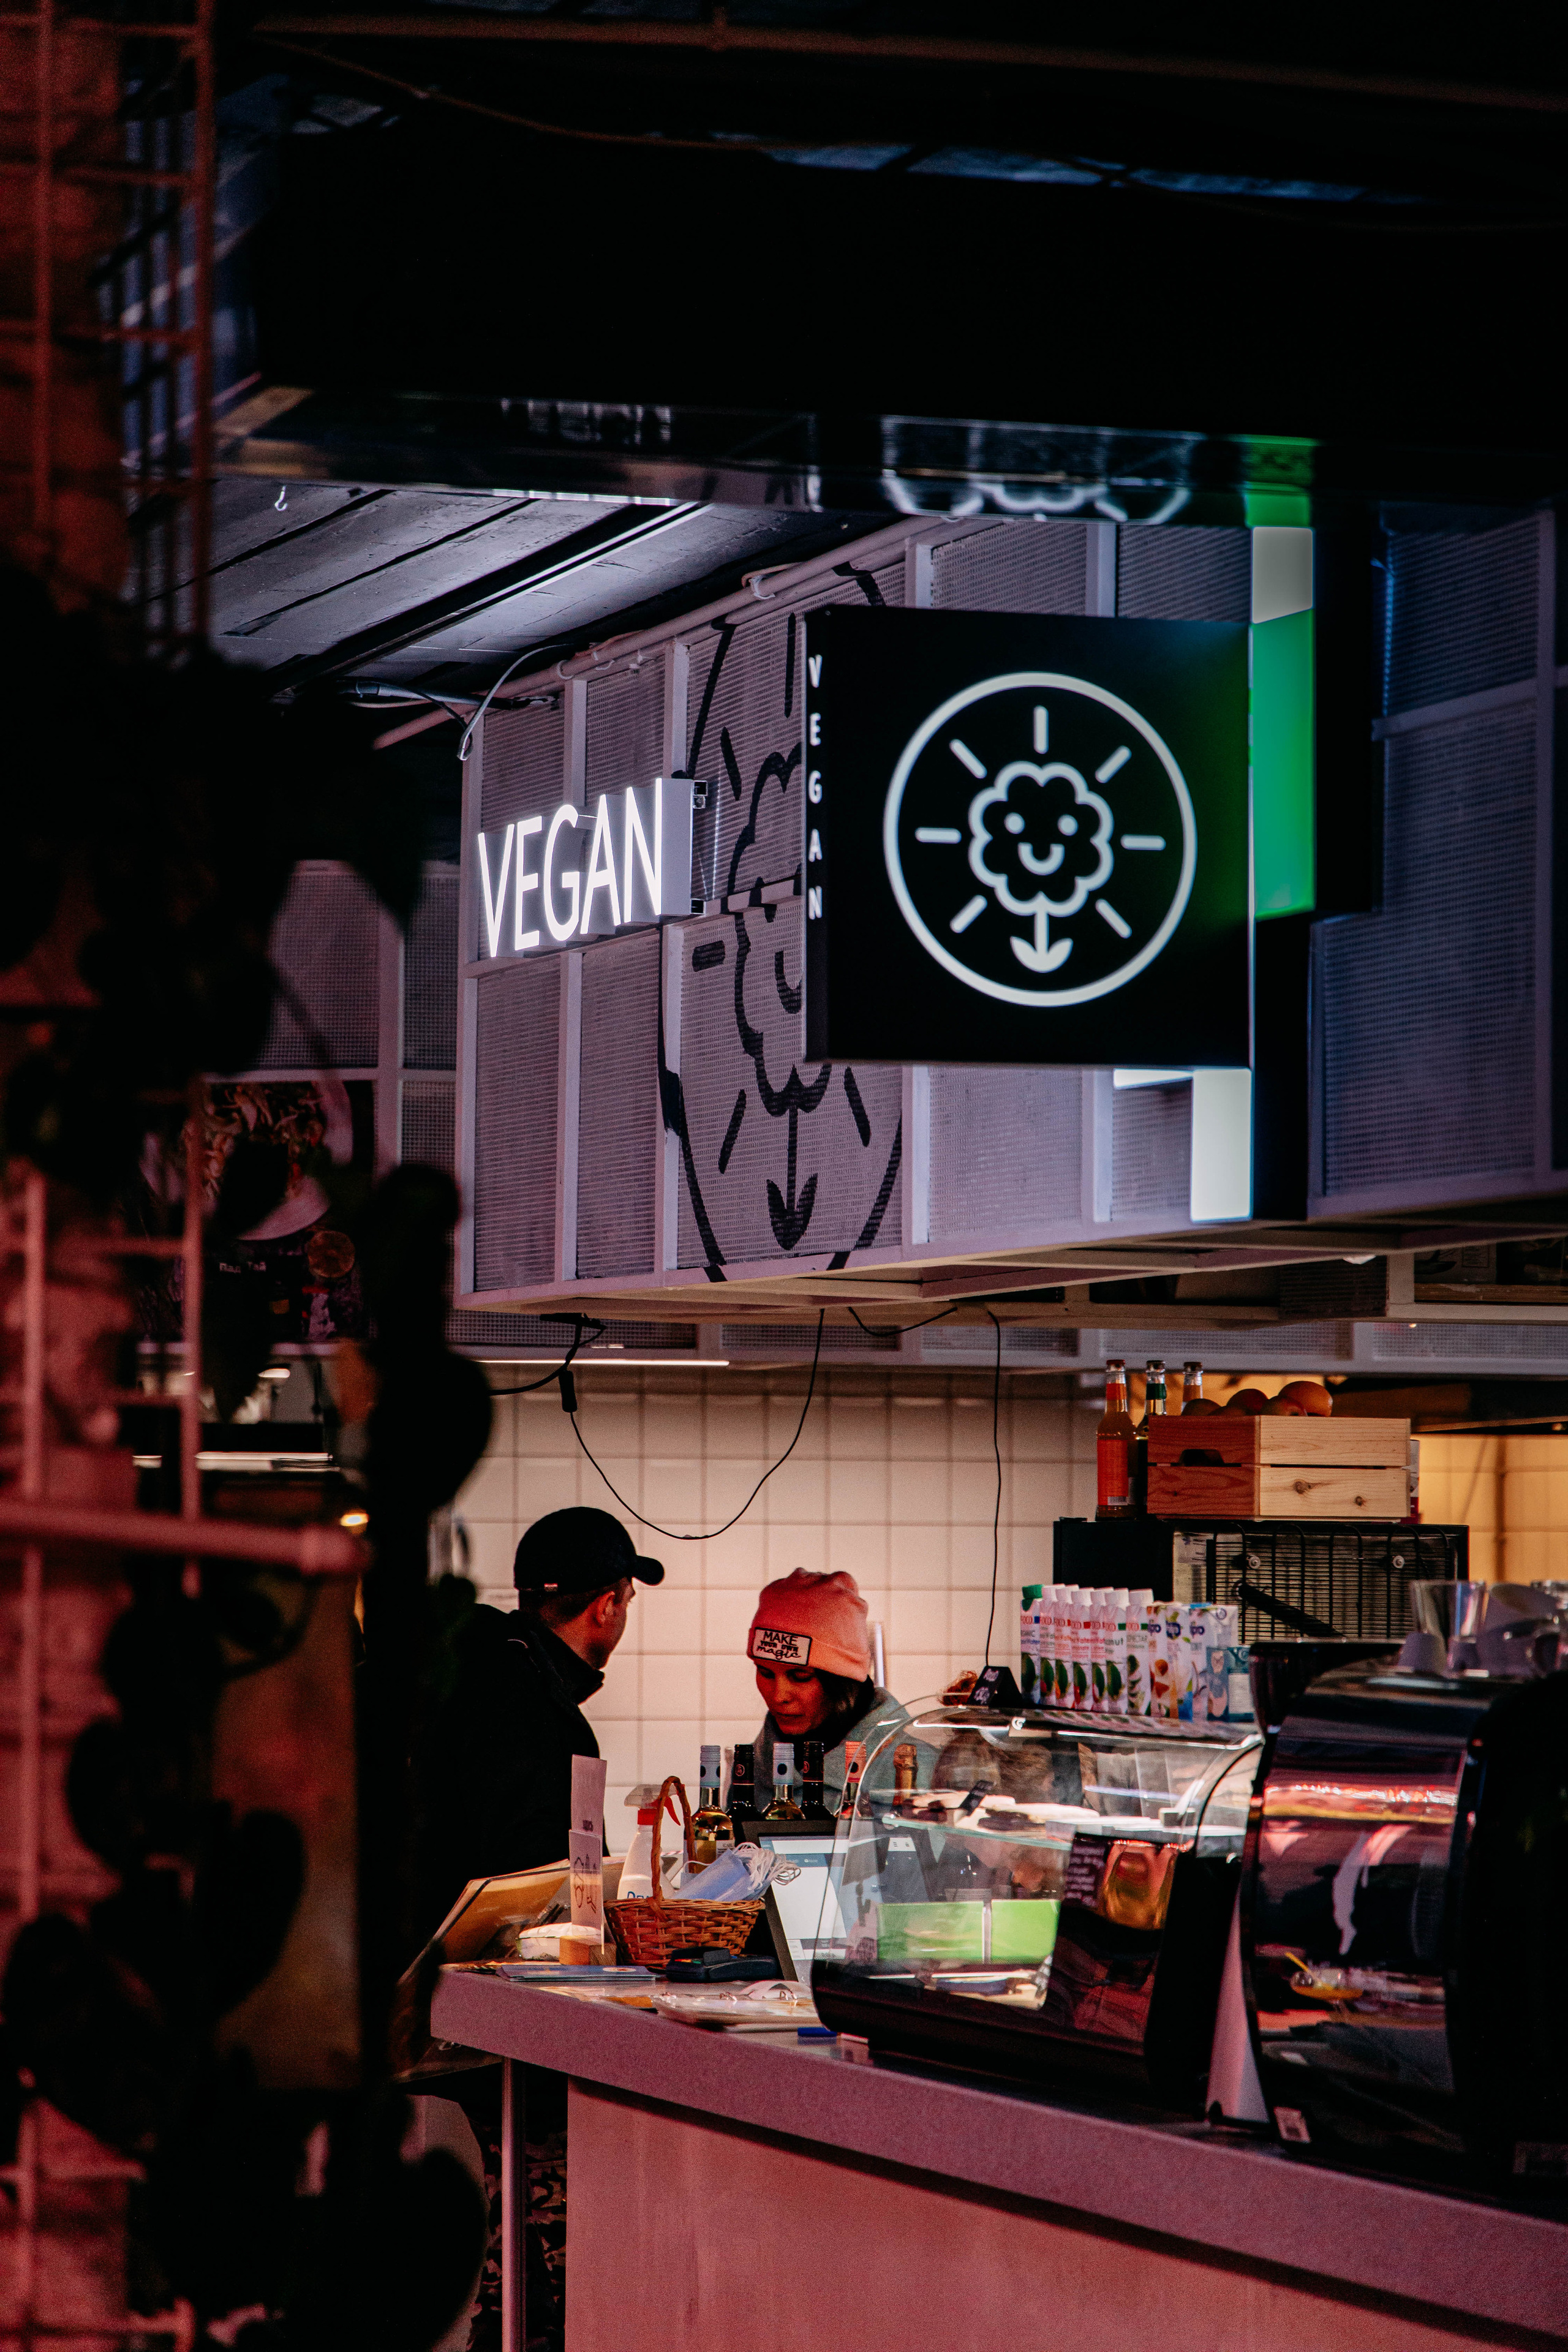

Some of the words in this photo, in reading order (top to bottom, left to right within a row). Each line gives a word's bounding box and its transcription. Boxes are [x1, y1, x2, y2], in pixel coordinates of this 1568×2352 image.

[808, 654, 823, 920] VEGAN
[478, 777, 662, 958] VEGAN
[757, 1646, 801, 1660] magic
[764, 1631, 798, 1646] MAKE
